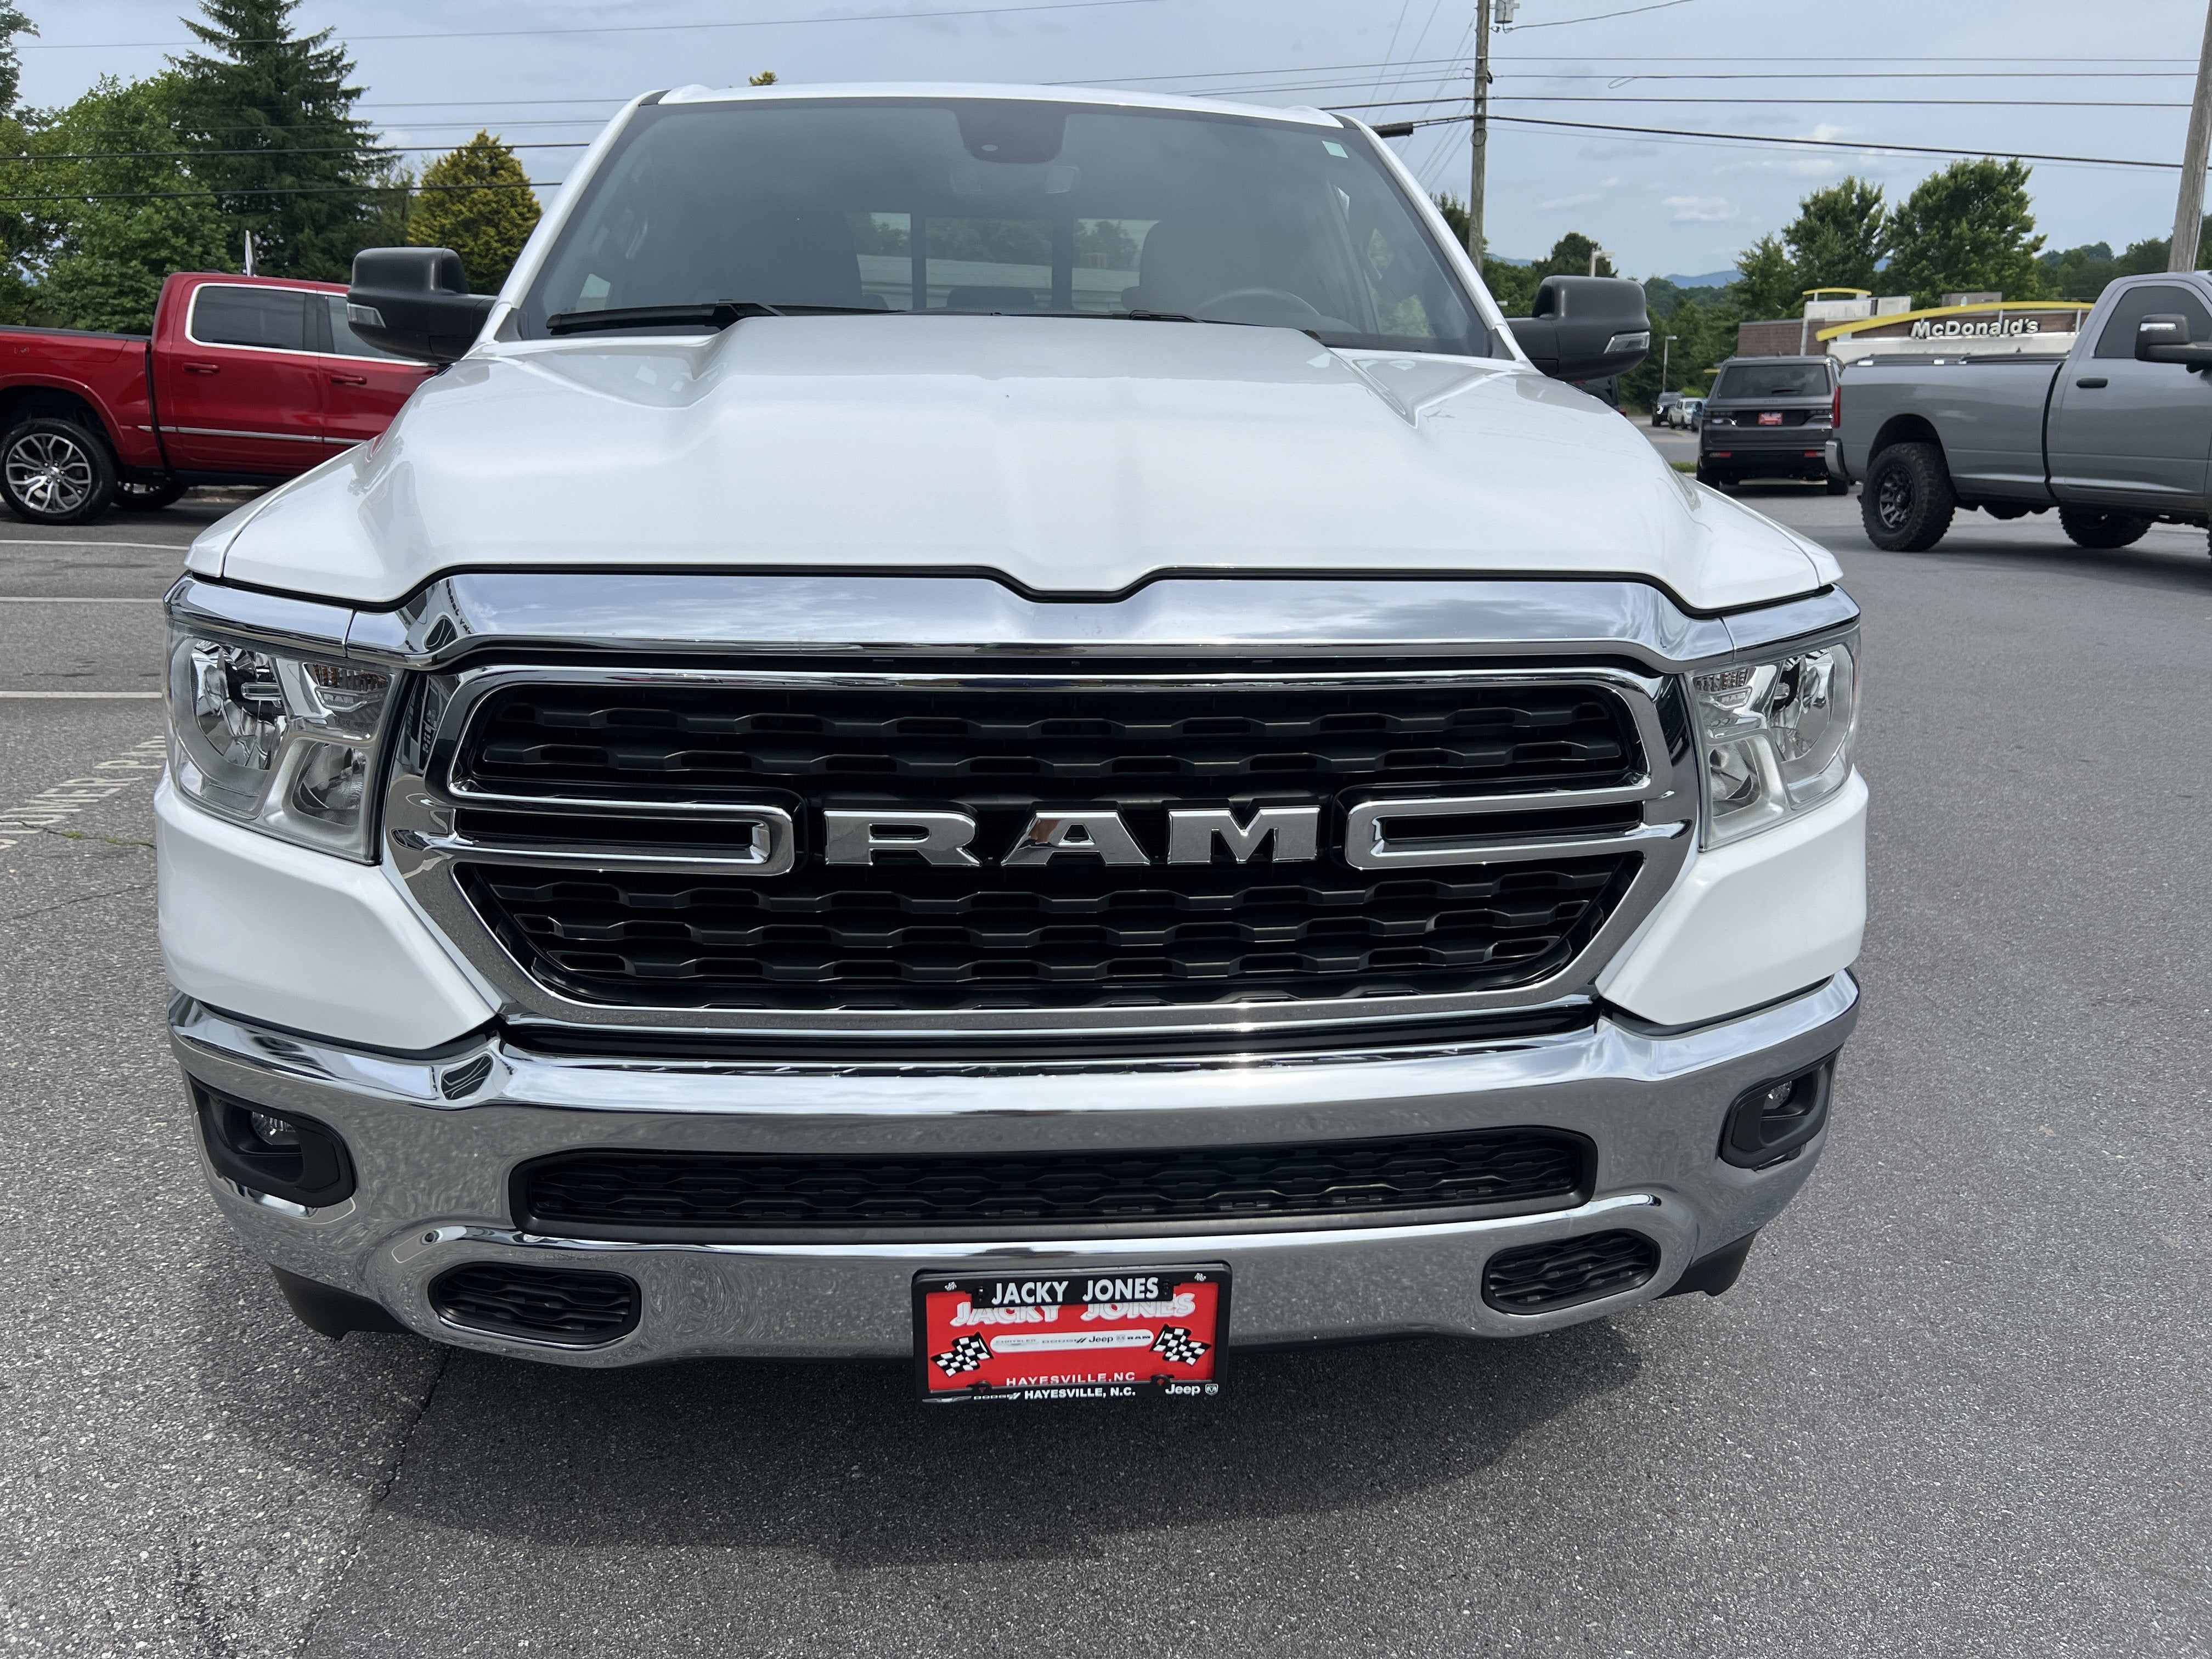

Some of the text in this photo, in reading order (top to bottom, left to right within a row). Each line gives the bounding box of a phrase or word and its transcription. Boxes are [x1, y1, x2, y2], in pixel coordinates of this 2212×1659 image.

[1910, 318, 2039, 338] McDonald's
[822, 806, 1322, 867] RAM
[991, 1277, 1159, 1305] JACKY JONES
[1024, 1387, 1136, 1400] HAYESVILLE, N.C.
[1165, 1384, 1201, 1396] Jeep
